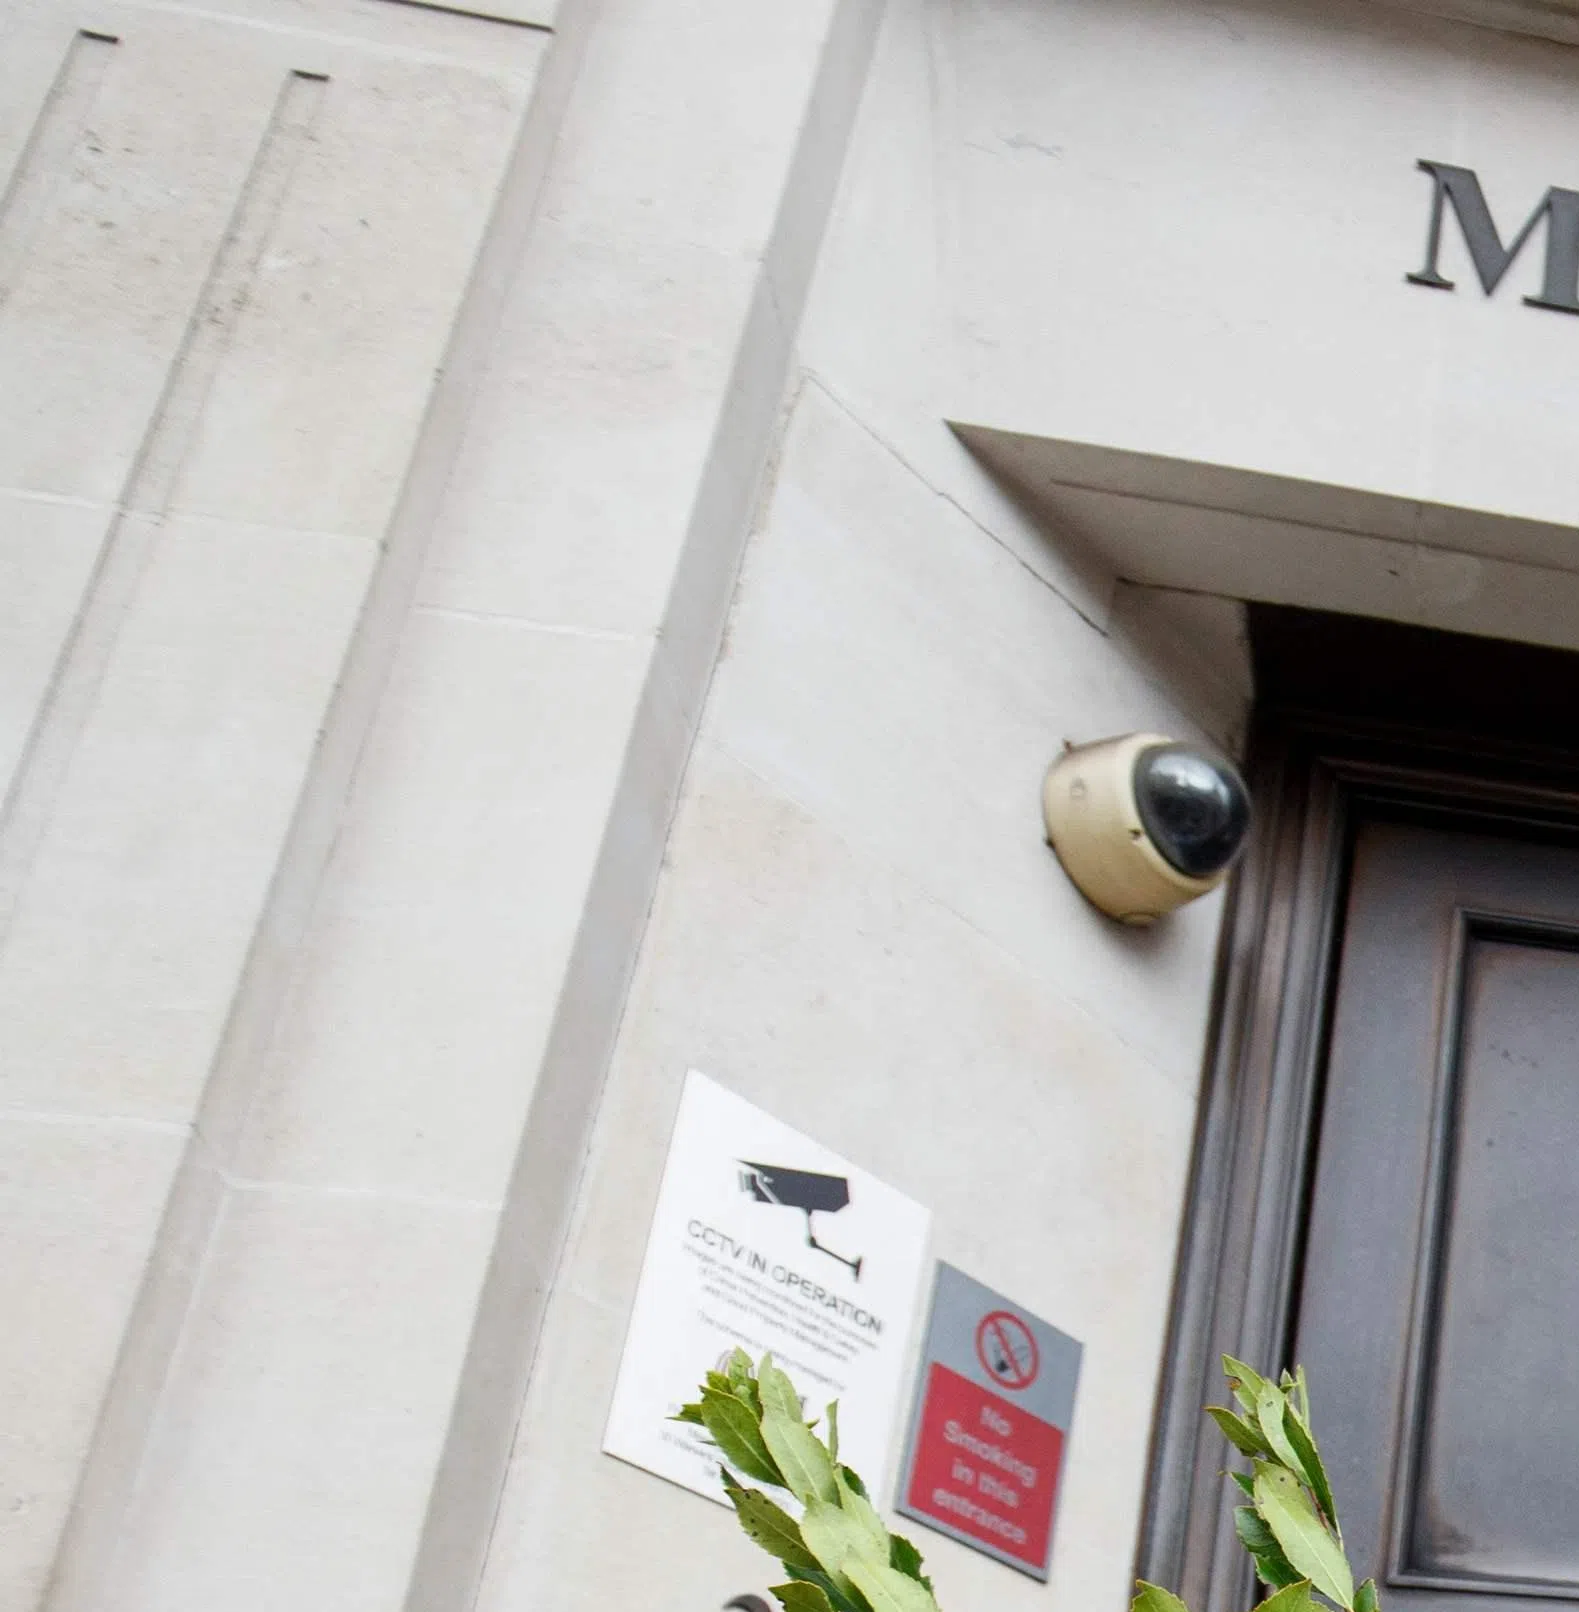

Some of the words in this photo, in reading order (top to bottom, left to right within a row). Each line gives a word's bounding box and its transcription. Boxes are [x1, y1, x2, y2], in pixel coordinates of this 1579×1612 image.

[686, 1219, 745, 1259] CCTV
[749, 1251, 768, 1275] IN
[771, 1264, 884, 1335] OPERATION
[980, 1405, 1012, 1436] No
[943, 1420, 1037, 1488] Smoking
[952, 1457, 976, 1485] in
[978, 1471, 1020, 1508] this
[932, 1488, 1027, 1544] entrance
